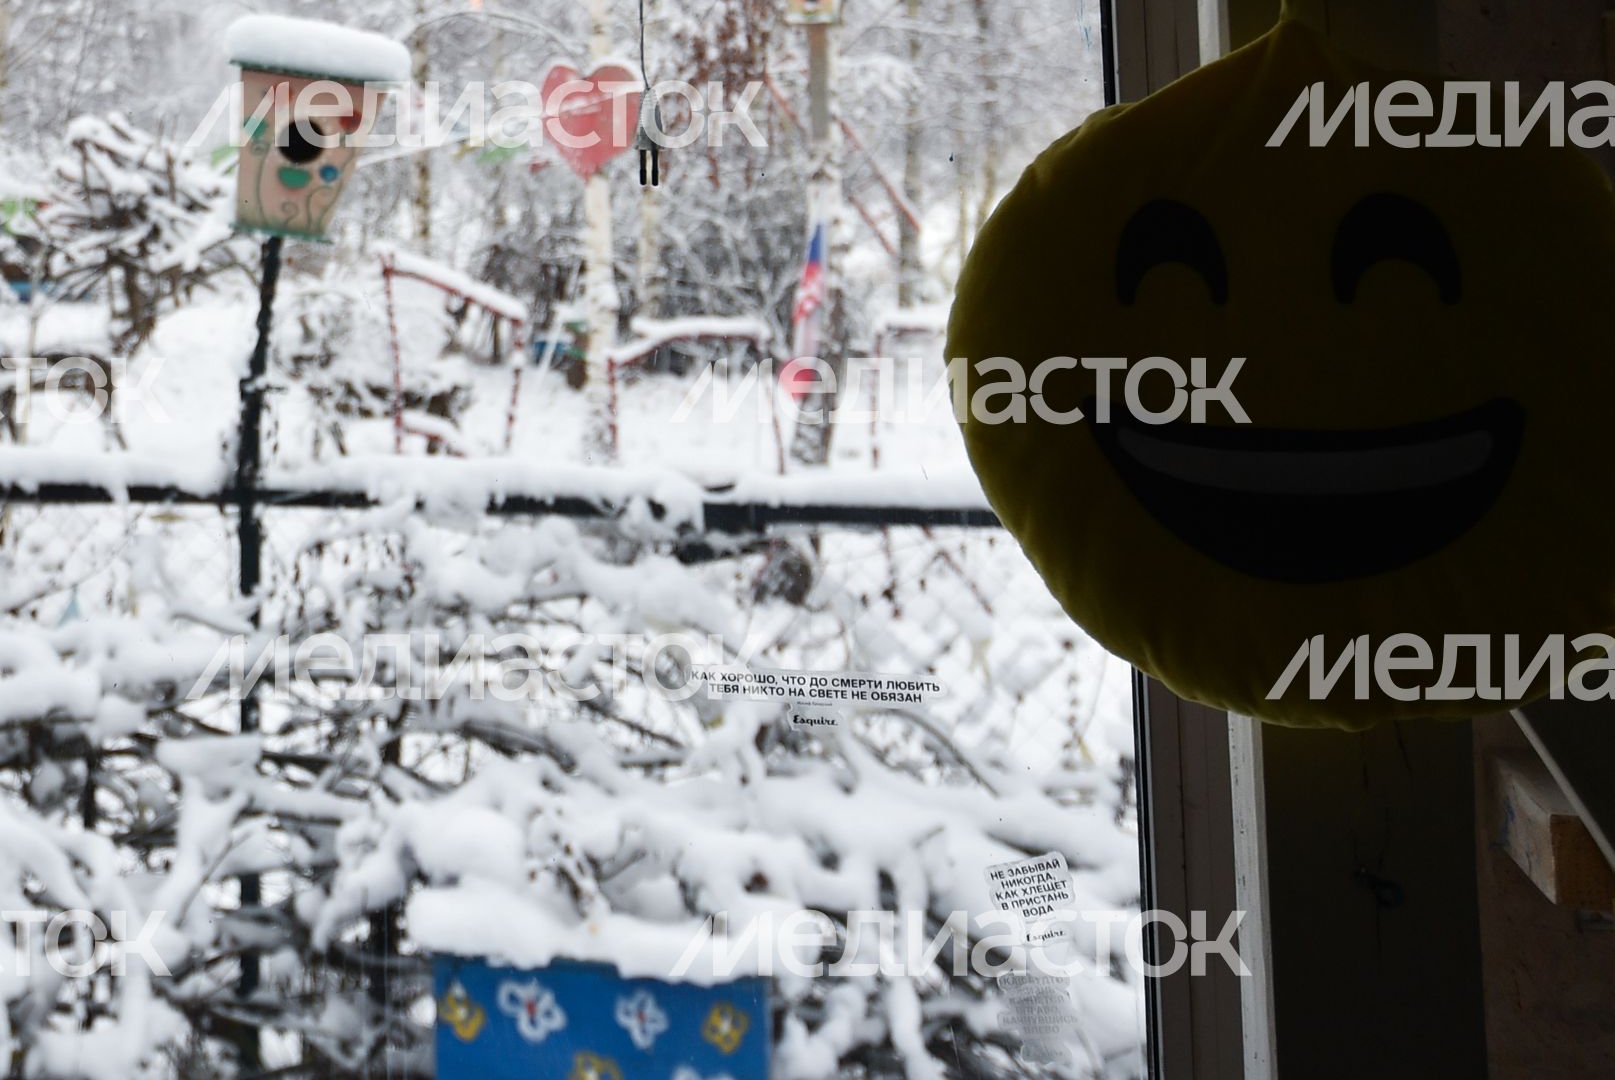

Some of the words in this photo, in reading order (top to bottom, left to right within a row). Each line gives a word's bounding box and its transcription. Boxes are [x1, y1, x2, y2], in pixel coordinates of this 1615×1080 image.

[691, 671, 716, 681] КАК
[720, 672, 778, 685] ХОРОШО,
[782, 676, 806, 685] ЧТО
[809, 676, 828, 688] ДО
[831, 678, 883, 690] СМЕРТИ
[886, 680, 940, 692] ЛЮБИТЬ
[709, 683, 739, 693] ТЕБЯ
[743, 685, 785, 696] НИКТО
[789, 687, 806, 697] НА
[809, 688, 848, 699] СВЕТЕ
[851, 690, 867, 700] НЕ
[871, 691, 922, 703] ОБЯЗАН
[793, 714, 838, 726] Esquire
[990, 870, 1005, 881] НЕ
[1007, 858, 1061, 877] ЗАБЫВАЙ
[995, 889, 1018, 901] КАК
[1021, 880, 1067, 896] ХЛЕЩЕТ
[1001, 872, 1056, 889] НИКОГДА,
[1001, 902, 1009, 911] В
[1011, 891, 1069, 909] ПРИСТАНЬ
[1022, 904, 1054, 918] ВОДА
